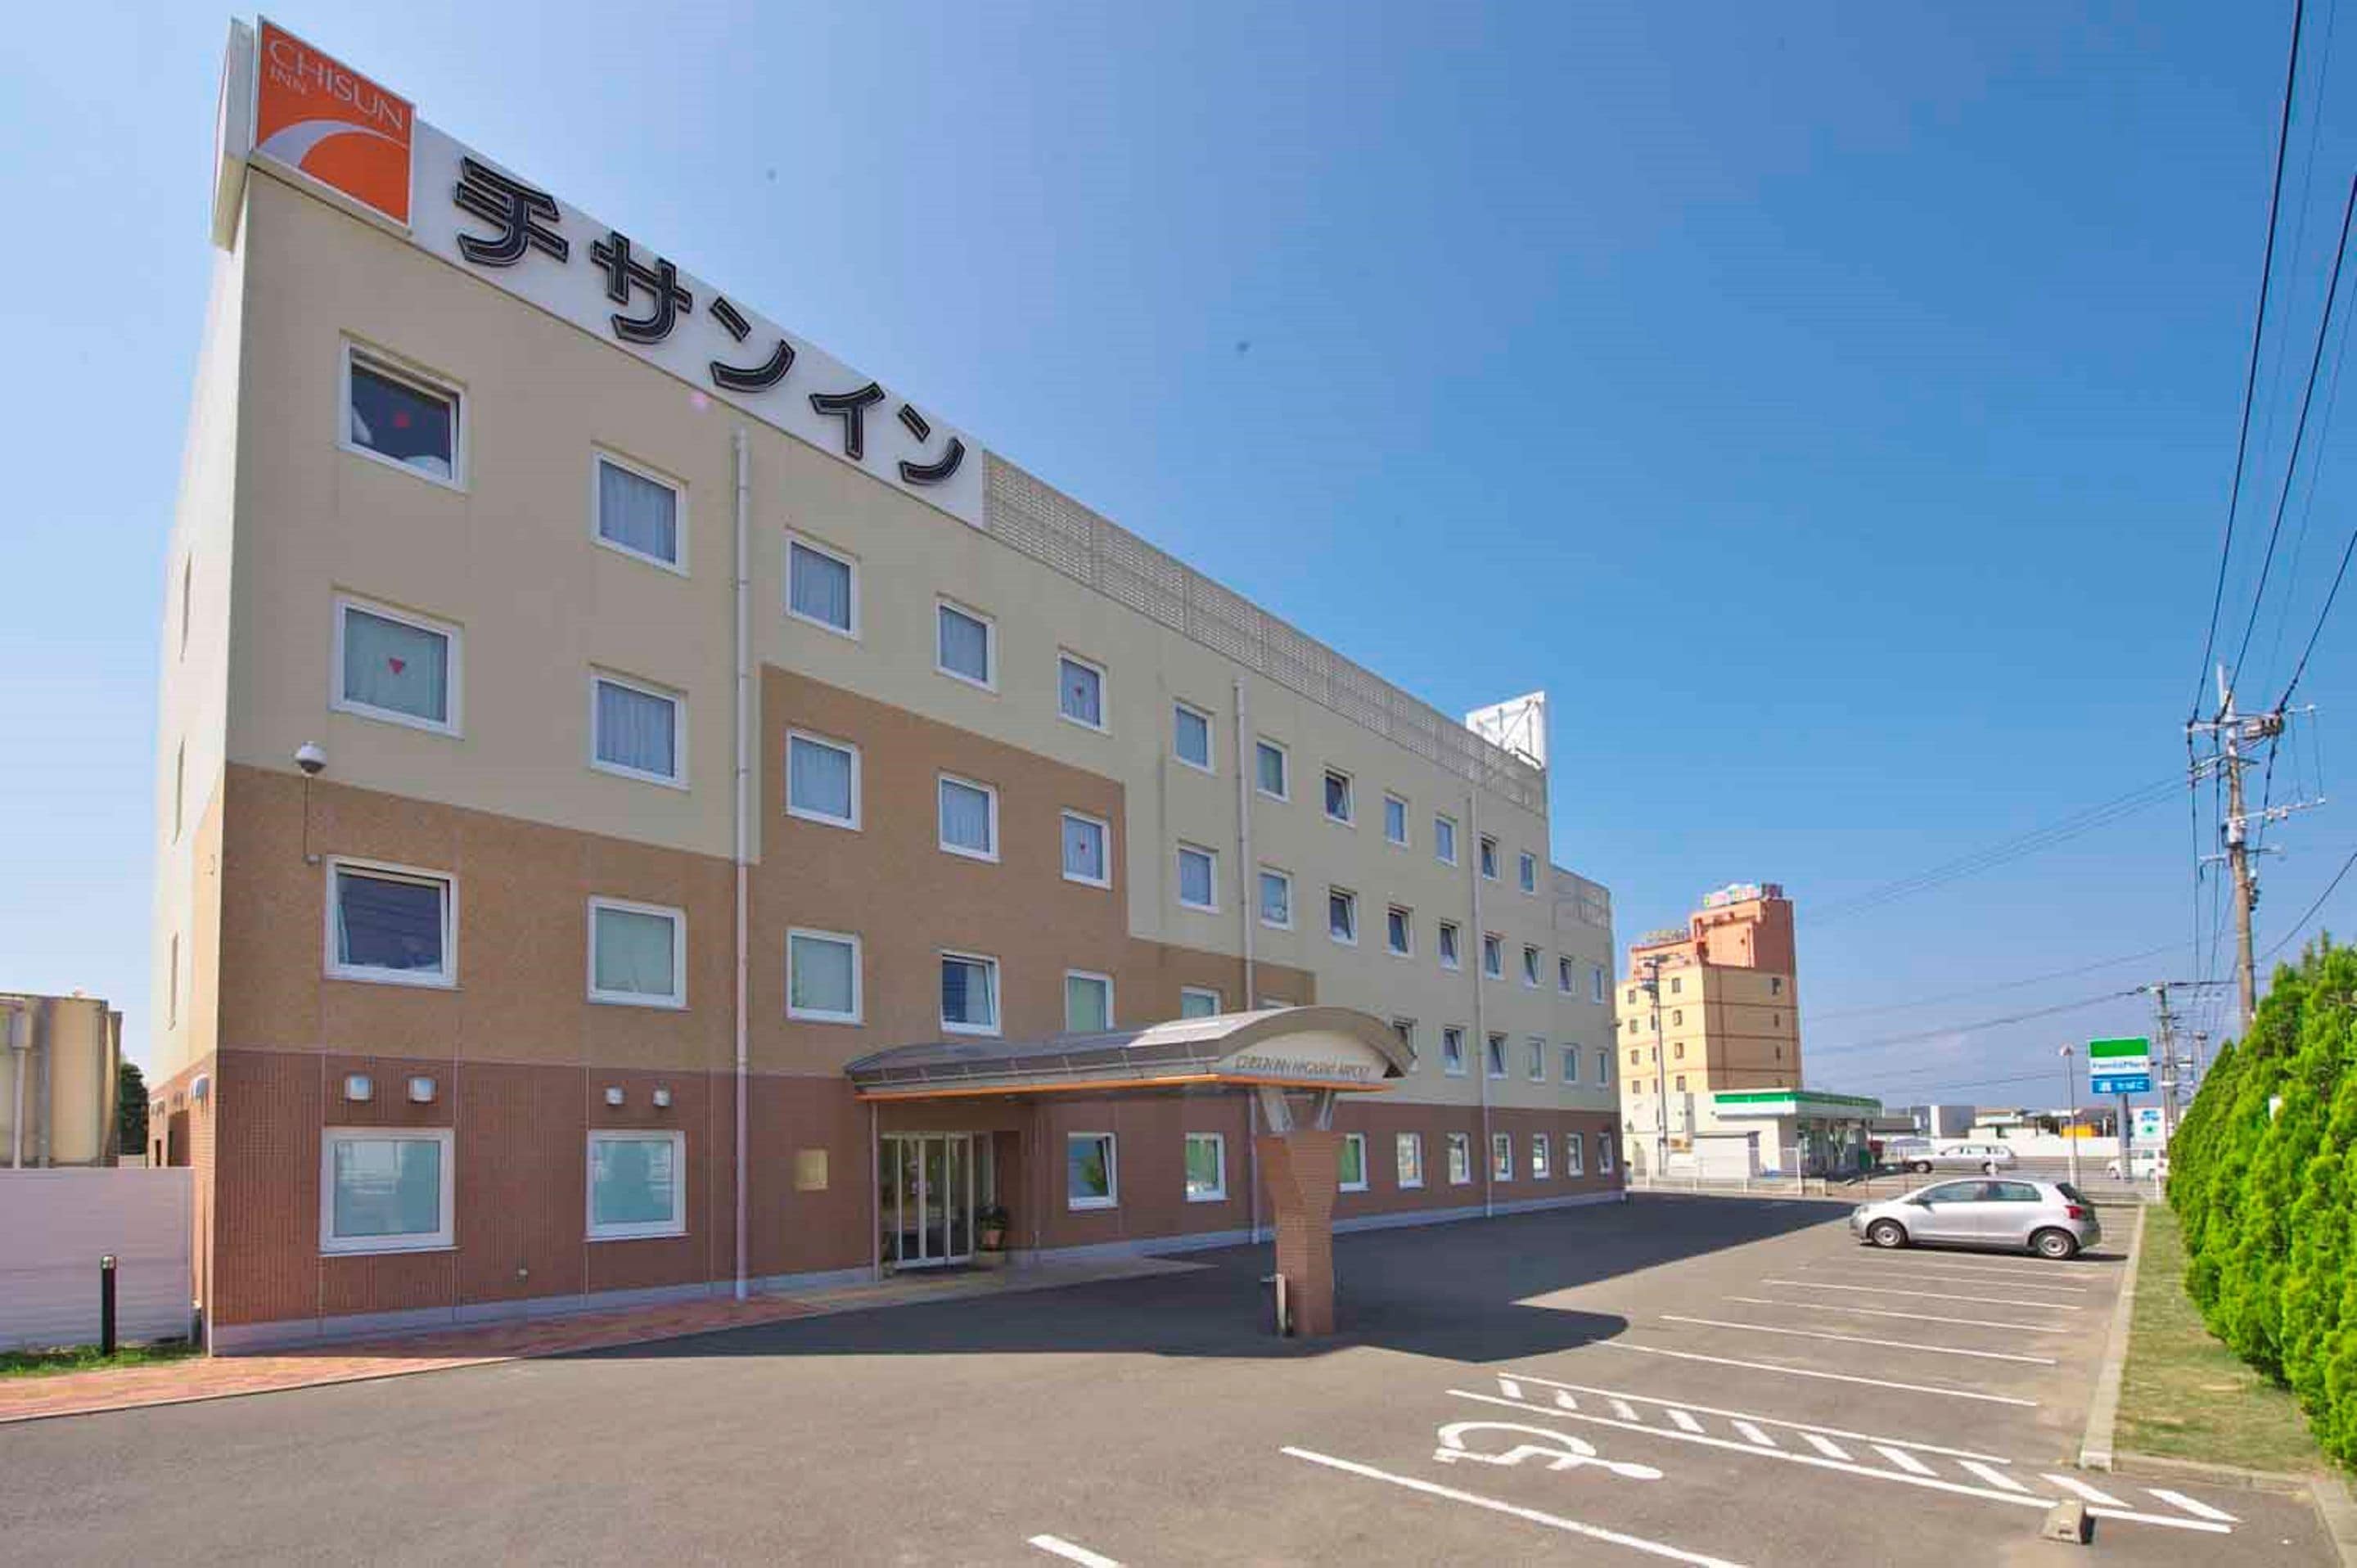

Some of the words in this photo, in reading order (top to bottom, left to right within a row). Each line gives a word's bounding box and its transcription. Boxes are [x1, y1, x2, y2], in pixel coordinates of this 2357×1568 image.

[269, 41, 403, 130] CHISUN
[270, 63, 306, 97] INN
[452, 155, 966, 486] チサンイン
